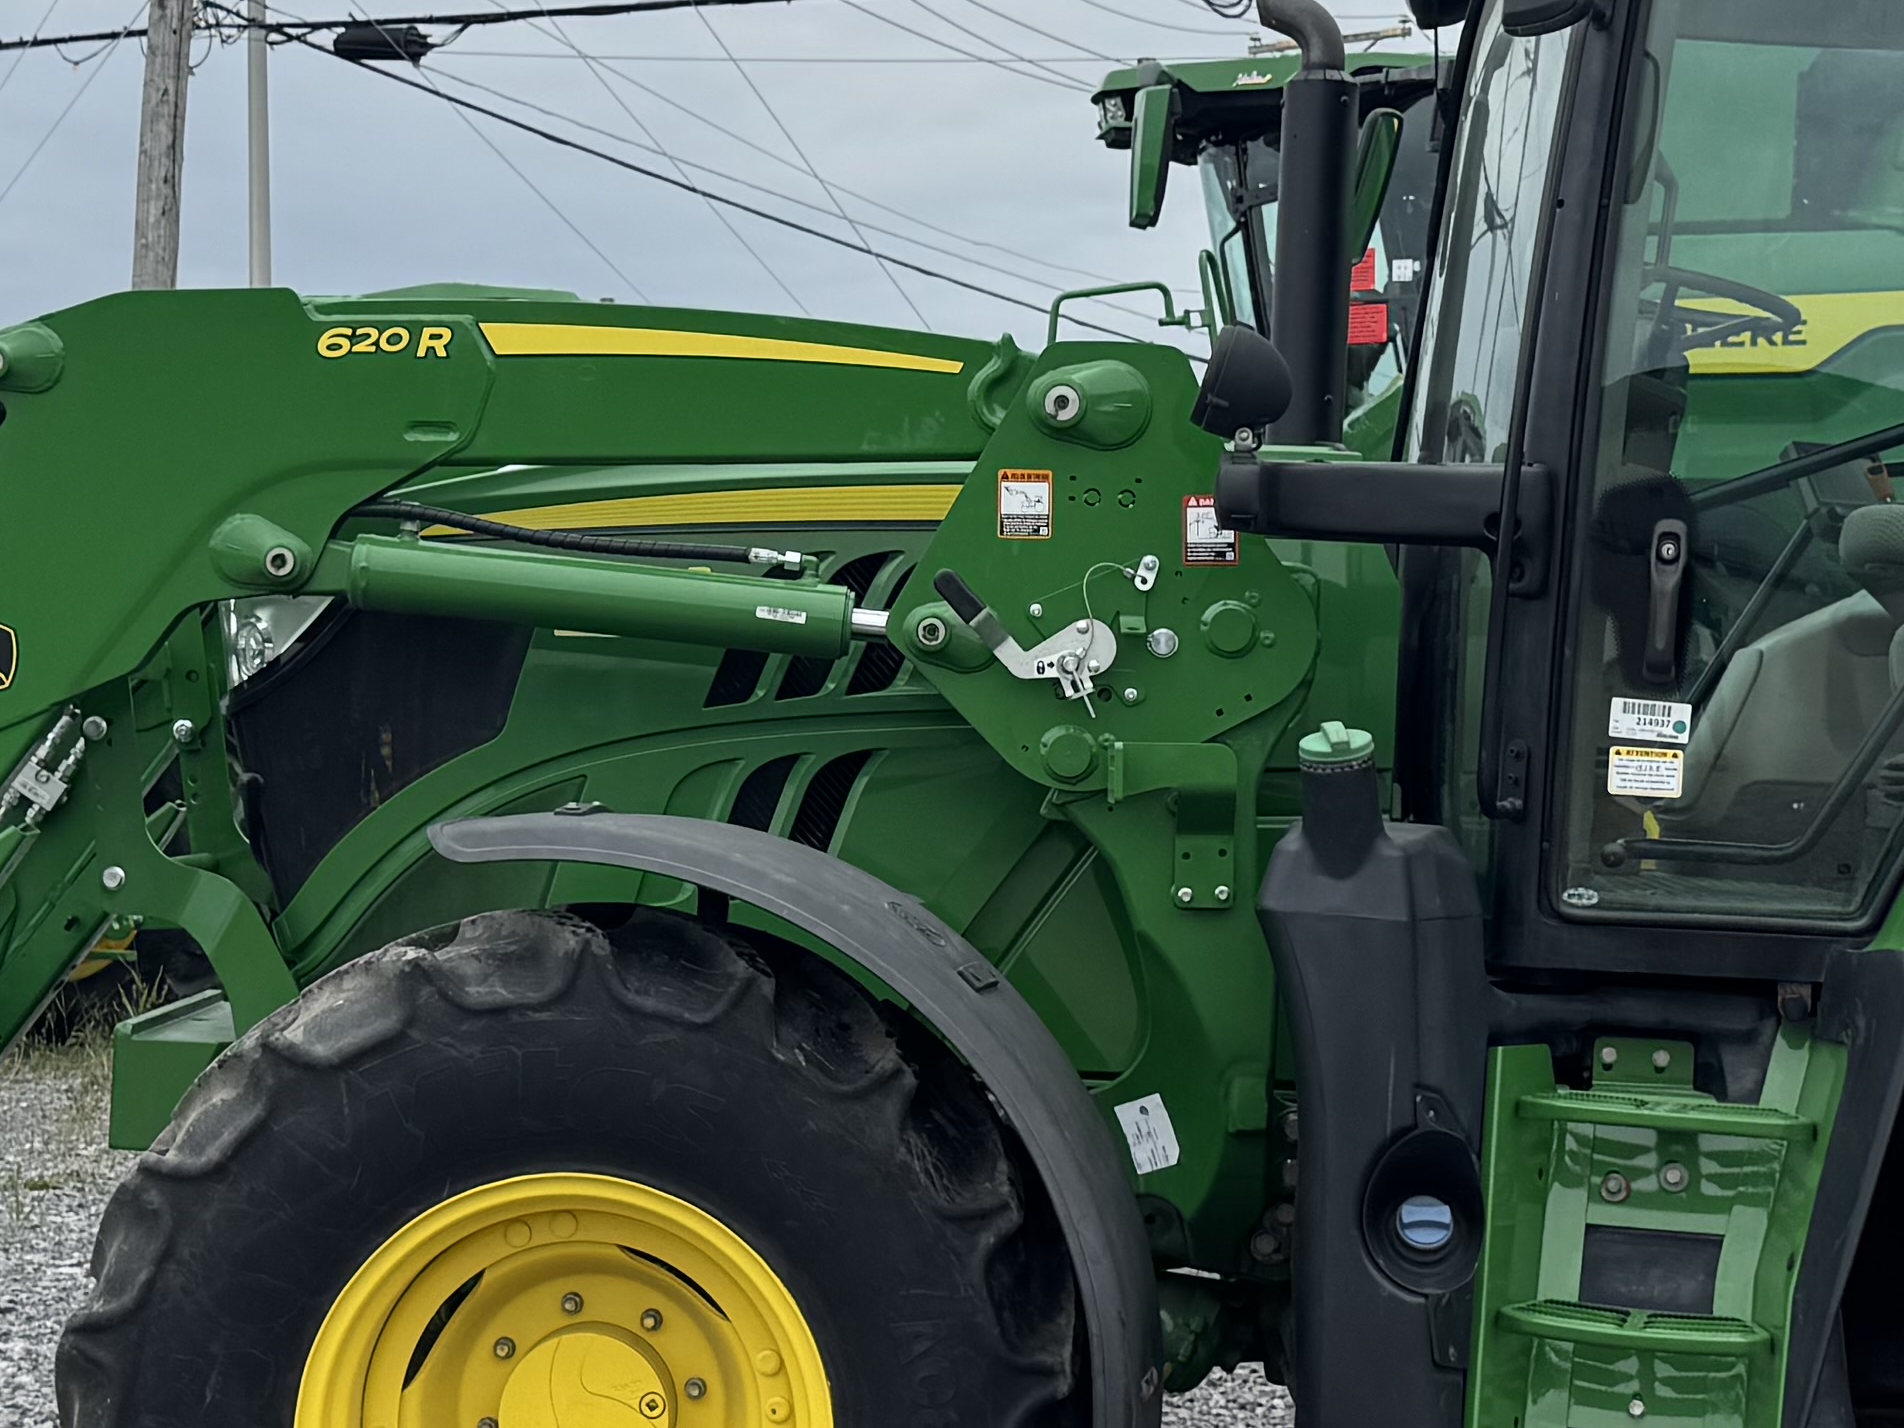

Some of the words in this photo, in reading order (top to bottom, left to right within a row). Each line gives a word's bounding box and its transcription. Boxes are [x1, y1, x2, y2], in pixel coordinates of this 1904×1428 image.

[315, 325, 413, 360] 620
[414, 325, 454, 360] R
[1635, 716, 1672, 729] 214937
